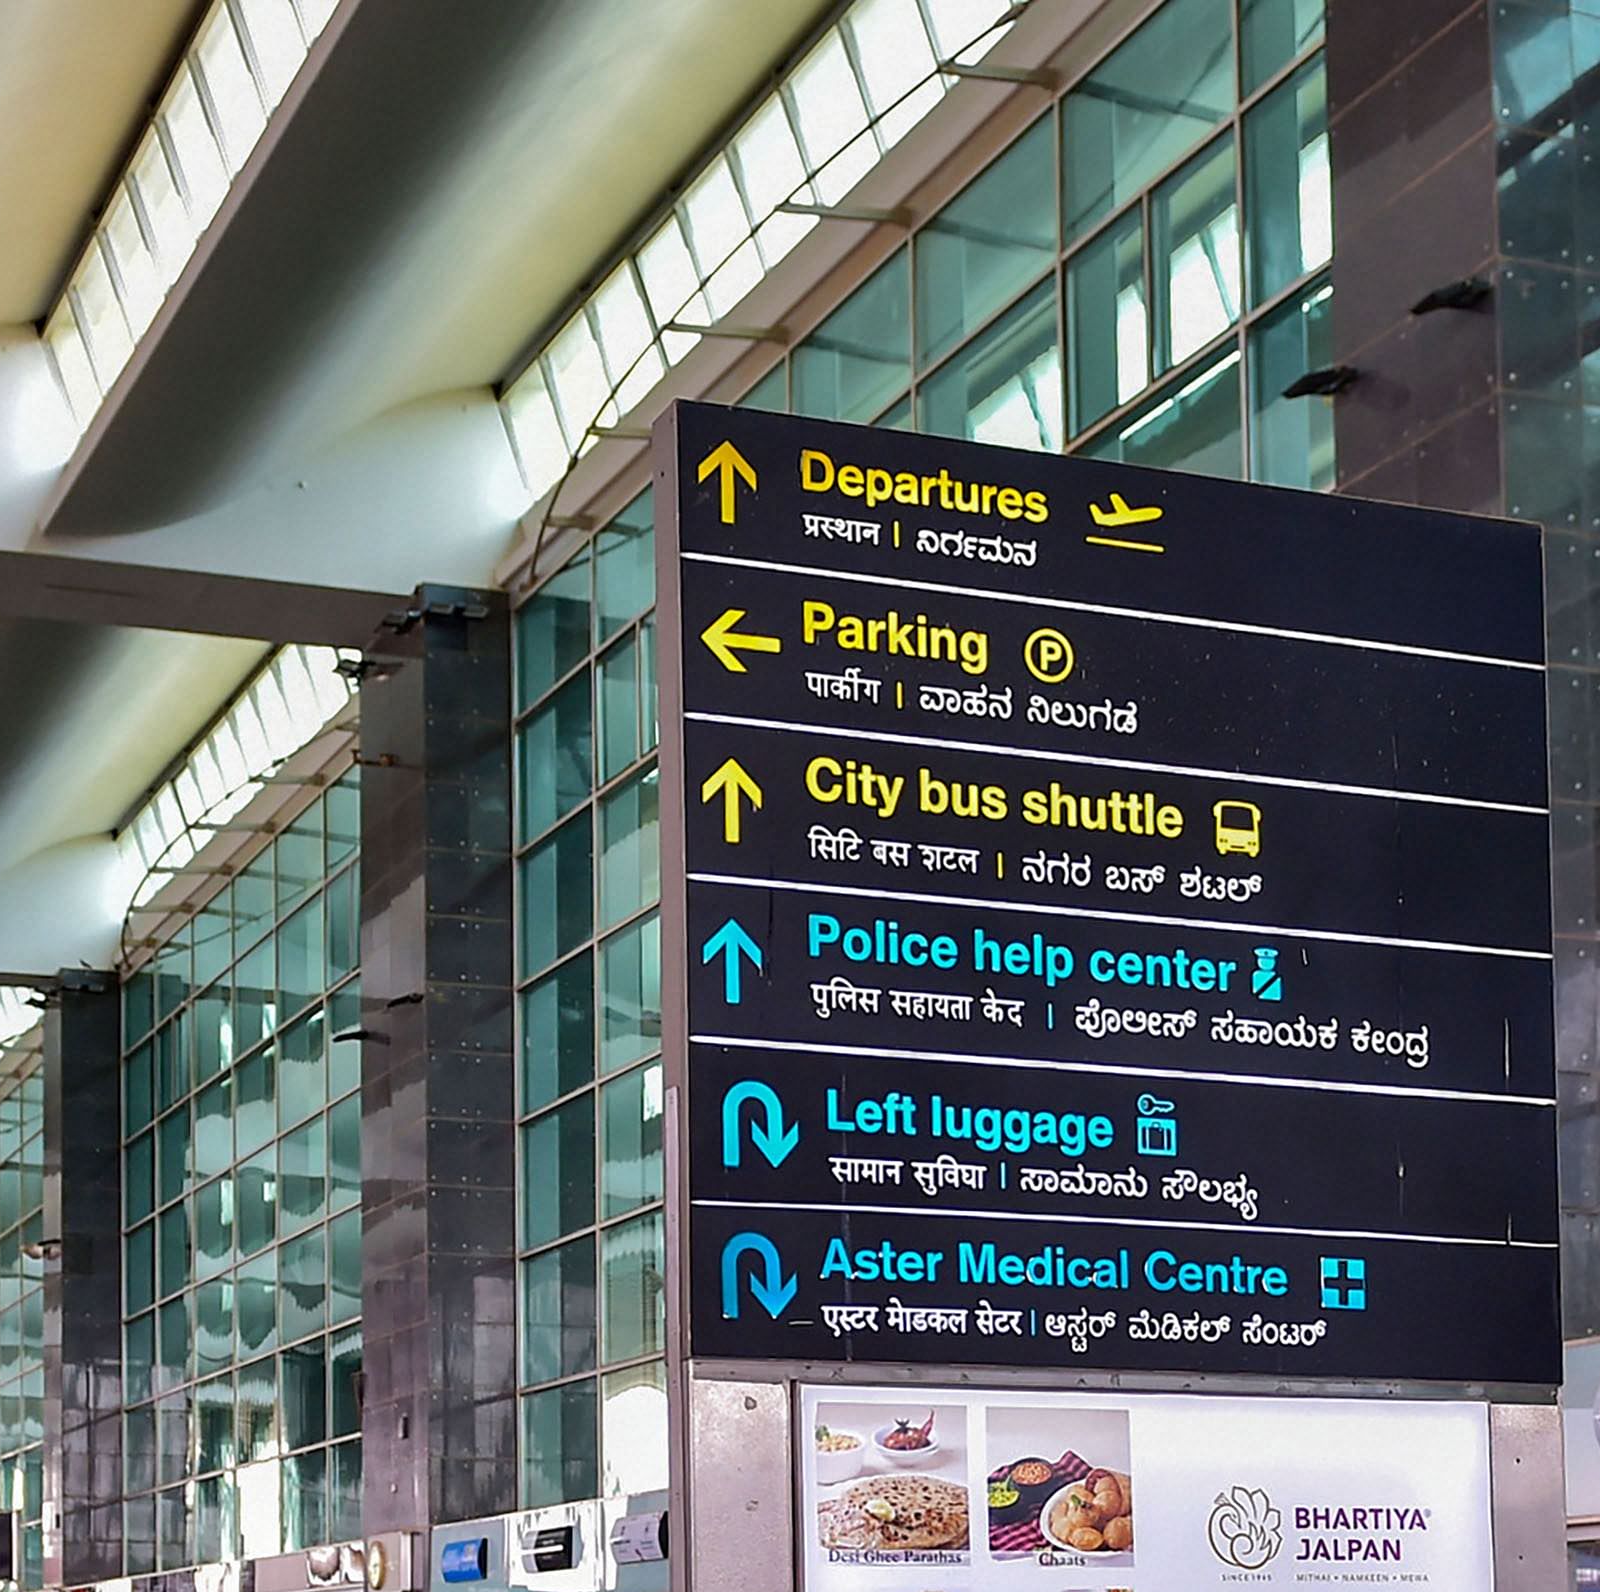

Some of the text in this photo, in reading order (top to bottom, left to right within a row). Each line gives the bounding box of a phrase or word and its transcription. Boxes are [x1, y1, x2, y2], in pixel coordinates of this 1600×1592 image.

[801, 450, 1048, 522] Departures
[803, 515, 881, 545] प्रस्थान
[917, 530, 1036, 566] ನಿರ್ಗಮನ
[804, 601, 987, 674] Parking
[920, 684, 1137, 733] ವಾಹನ ನಿಲುಗಡೆ
[806, 757, 1183, 837] City bus shuttle
[808, 825, 980, 873] सिटि बस शटल
[1023, 851, 1262, 901] ನಗರ ಬಸ್ ಶಟಲ್
[809, 914, 1236, 991] Police help center
[810, 977, 882, 1018] पुलिस
[889, 990, 973, 1020] सहायता
[1076, 999, 1428, 1067] ಪೊಲೀಸ್ ಸಹಾಯಕ ಕೇಂದ್ರ
[827, 1089, 1113, 1156] Left luggage
[829, 1157, 904, 1184] सामान
[1021, 1164, 1257, 1220] ಸಾಮಾನು ಸೌಲಭ್ಯ
[820, 1238, 1287, 1295] Aster Medical Centre
[821, 1306, 879, 1337] एस्टर
[1046, 1307, 1326, 1352] ಆಸ್ಟರ್ ಮೆಡಿಕಲ್ ಸೆಂಟರ್
[828, 1550, 962, 1564] Desi Ghee Parathas
[1039, 1554, 1085, 1567] Chaats
[1295, 1539, 1401, 1561] JALPAN
[1342, 1574, 1389, 1582] NAMKEEN
[1400, 1574, 1429, 1582] MEWA
